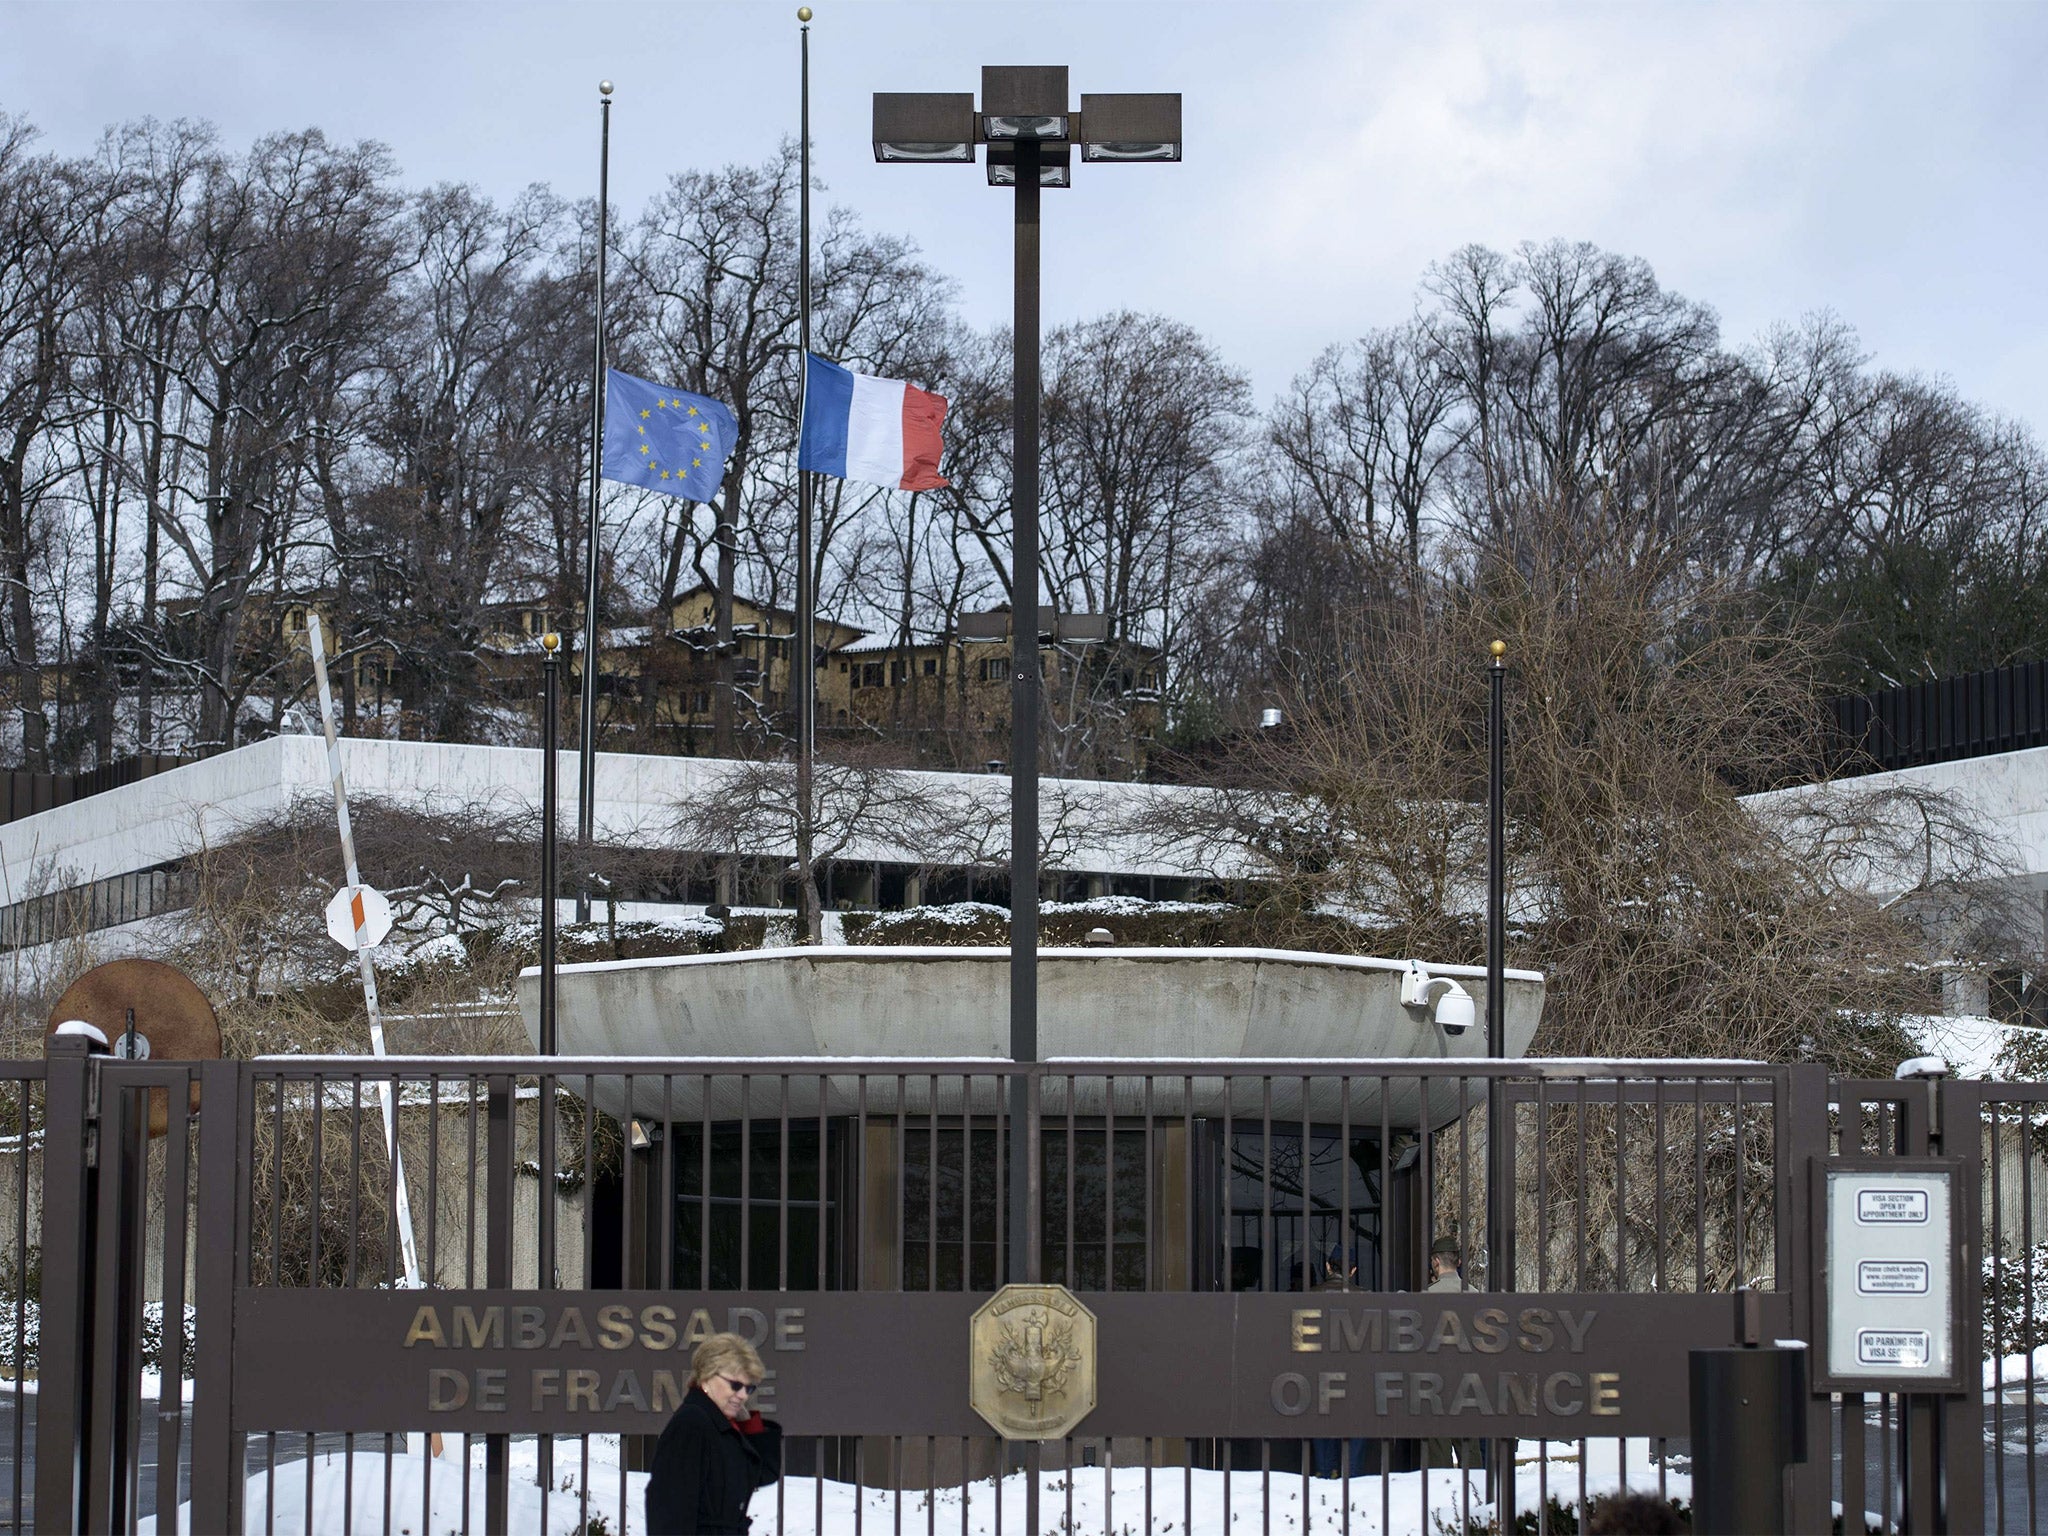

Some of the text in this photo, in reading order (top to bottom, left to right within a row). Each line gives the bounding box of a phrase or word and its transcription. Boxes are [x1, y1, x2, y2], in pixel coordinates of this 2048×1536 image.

[403, 1304, 806, 1351] AMBASSADE
[1292, 1307, 1597, 1353] EMBASSY
[1864, 1337, 1924, 1346] NO PARKING FOR
[1869, 1348, 1886, 1357] VISA
[428, 1368, 777, 1413] DE FRANE
[1271, 1371, 1621, 1416] OF FRANCE
